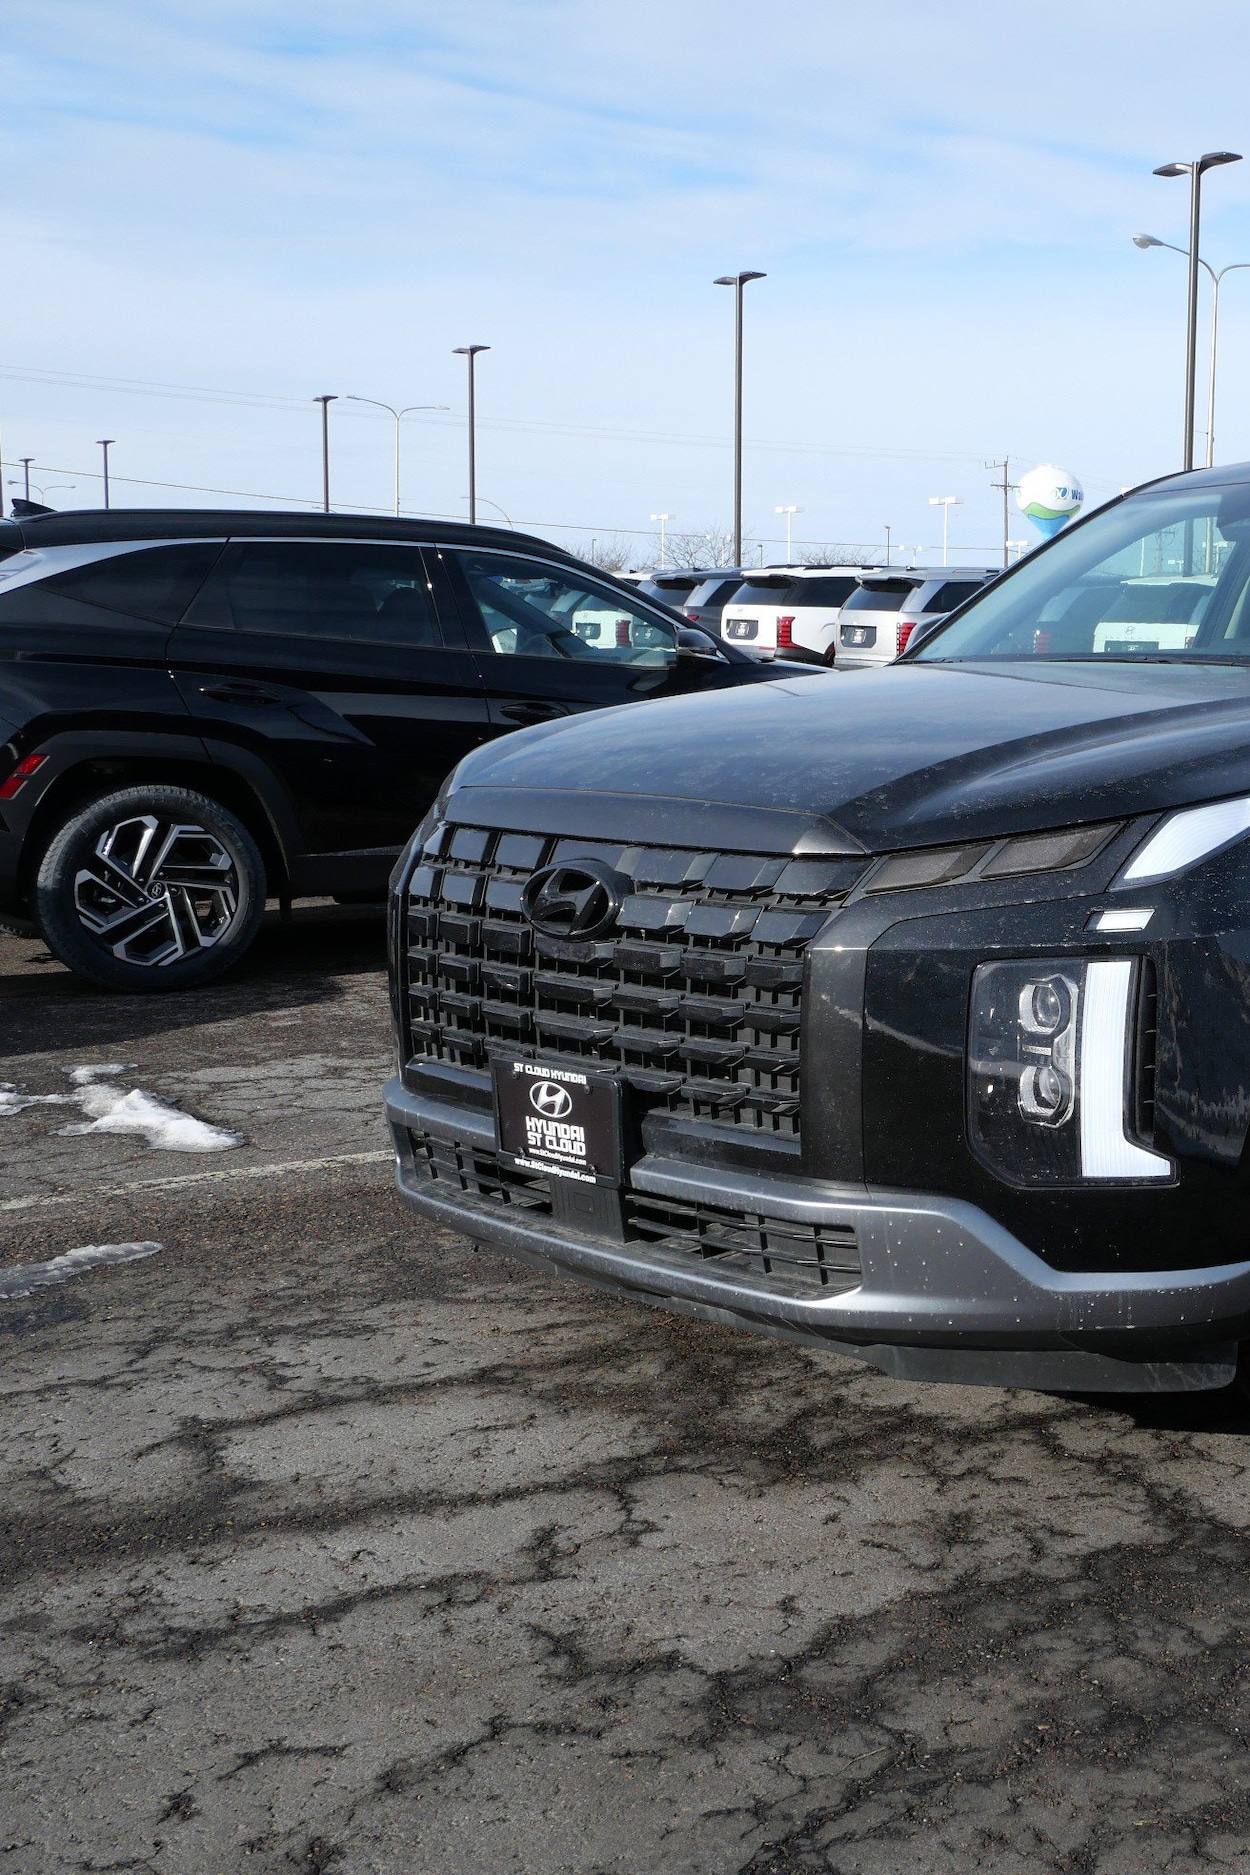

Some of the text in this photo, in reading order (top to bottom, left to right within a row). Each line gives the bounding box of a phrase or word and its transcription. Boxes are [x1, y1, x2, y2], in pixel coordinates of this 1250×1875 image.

[513, 1062, 587, 1085] ST CLOUD HYUNDAI
[525, 1115, 585, 1142] HYUNDAI
[527, 1131, 586, 1156] ST CLOUD
